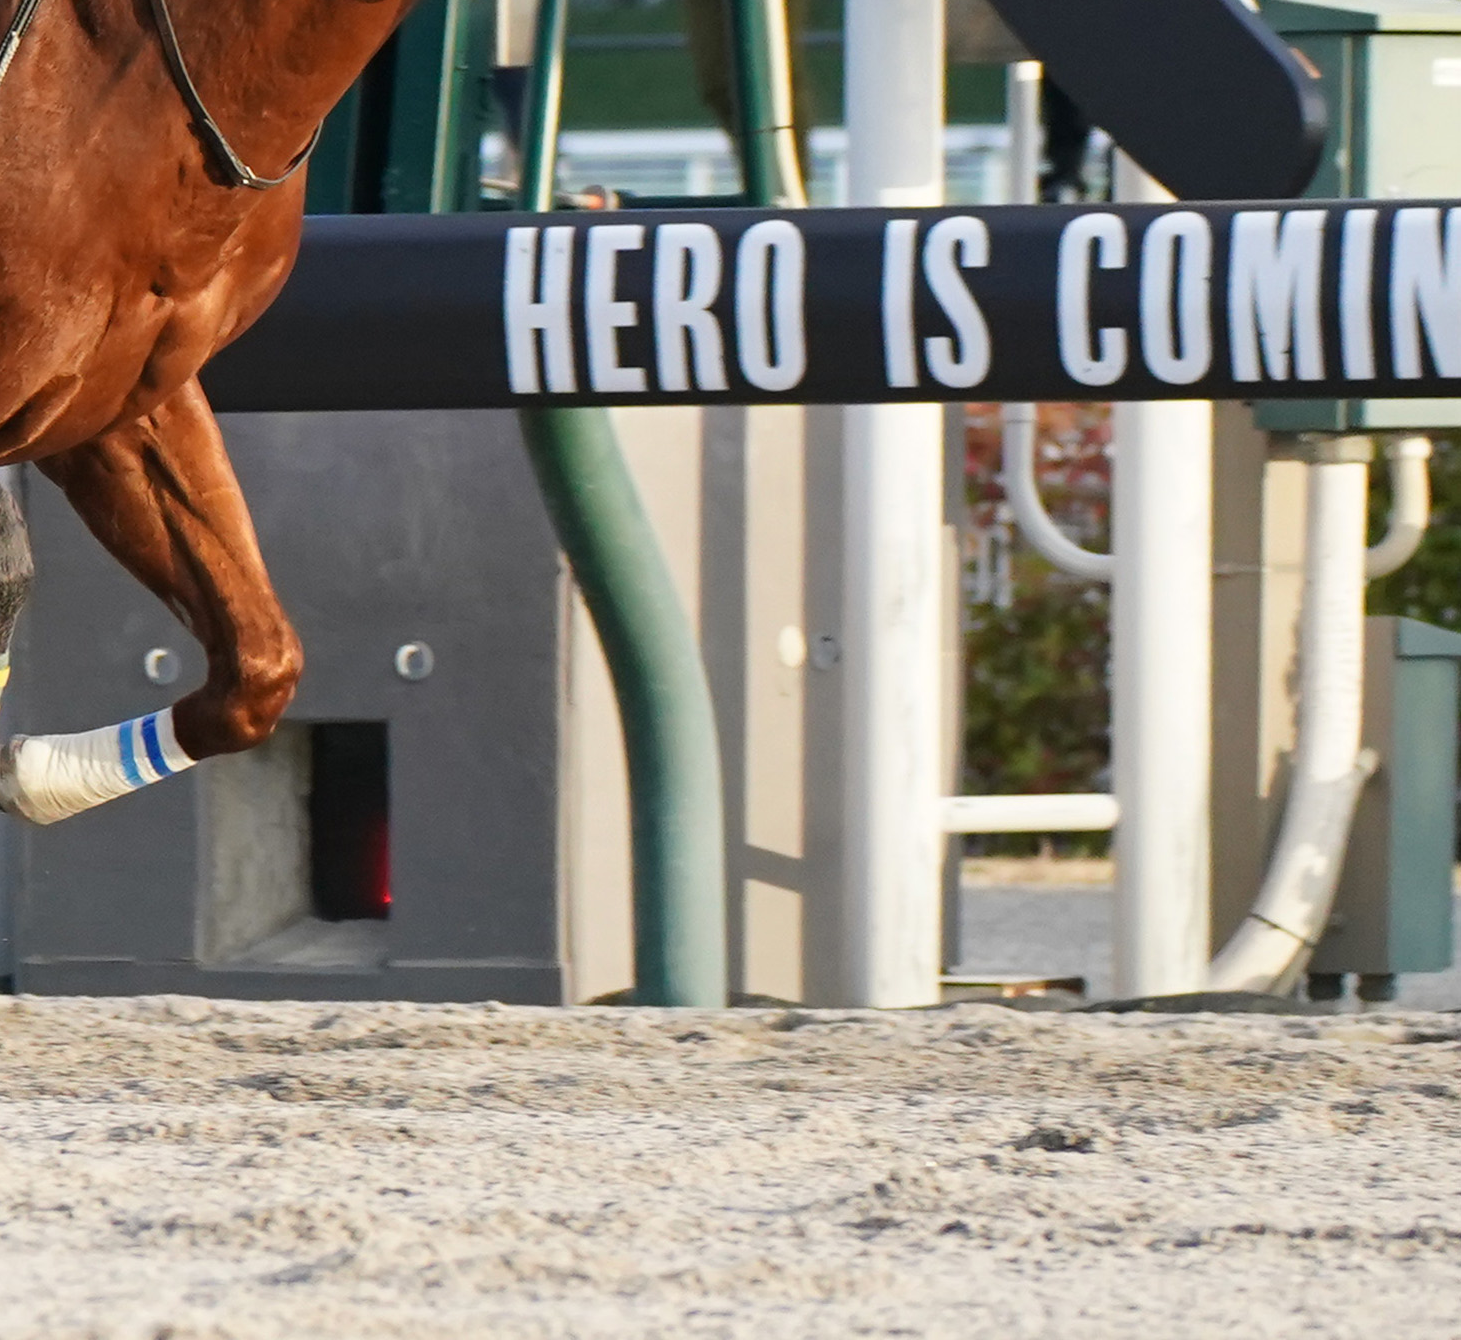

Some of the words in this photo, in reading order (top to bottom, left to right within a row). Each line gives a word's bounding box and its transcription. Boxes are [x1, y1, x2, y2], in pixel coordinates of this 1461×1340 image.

[504, 218, 806, 394] HERO
[884, 215, 990, 389] IS
[1058, 206, 1461, 387] COMIN
